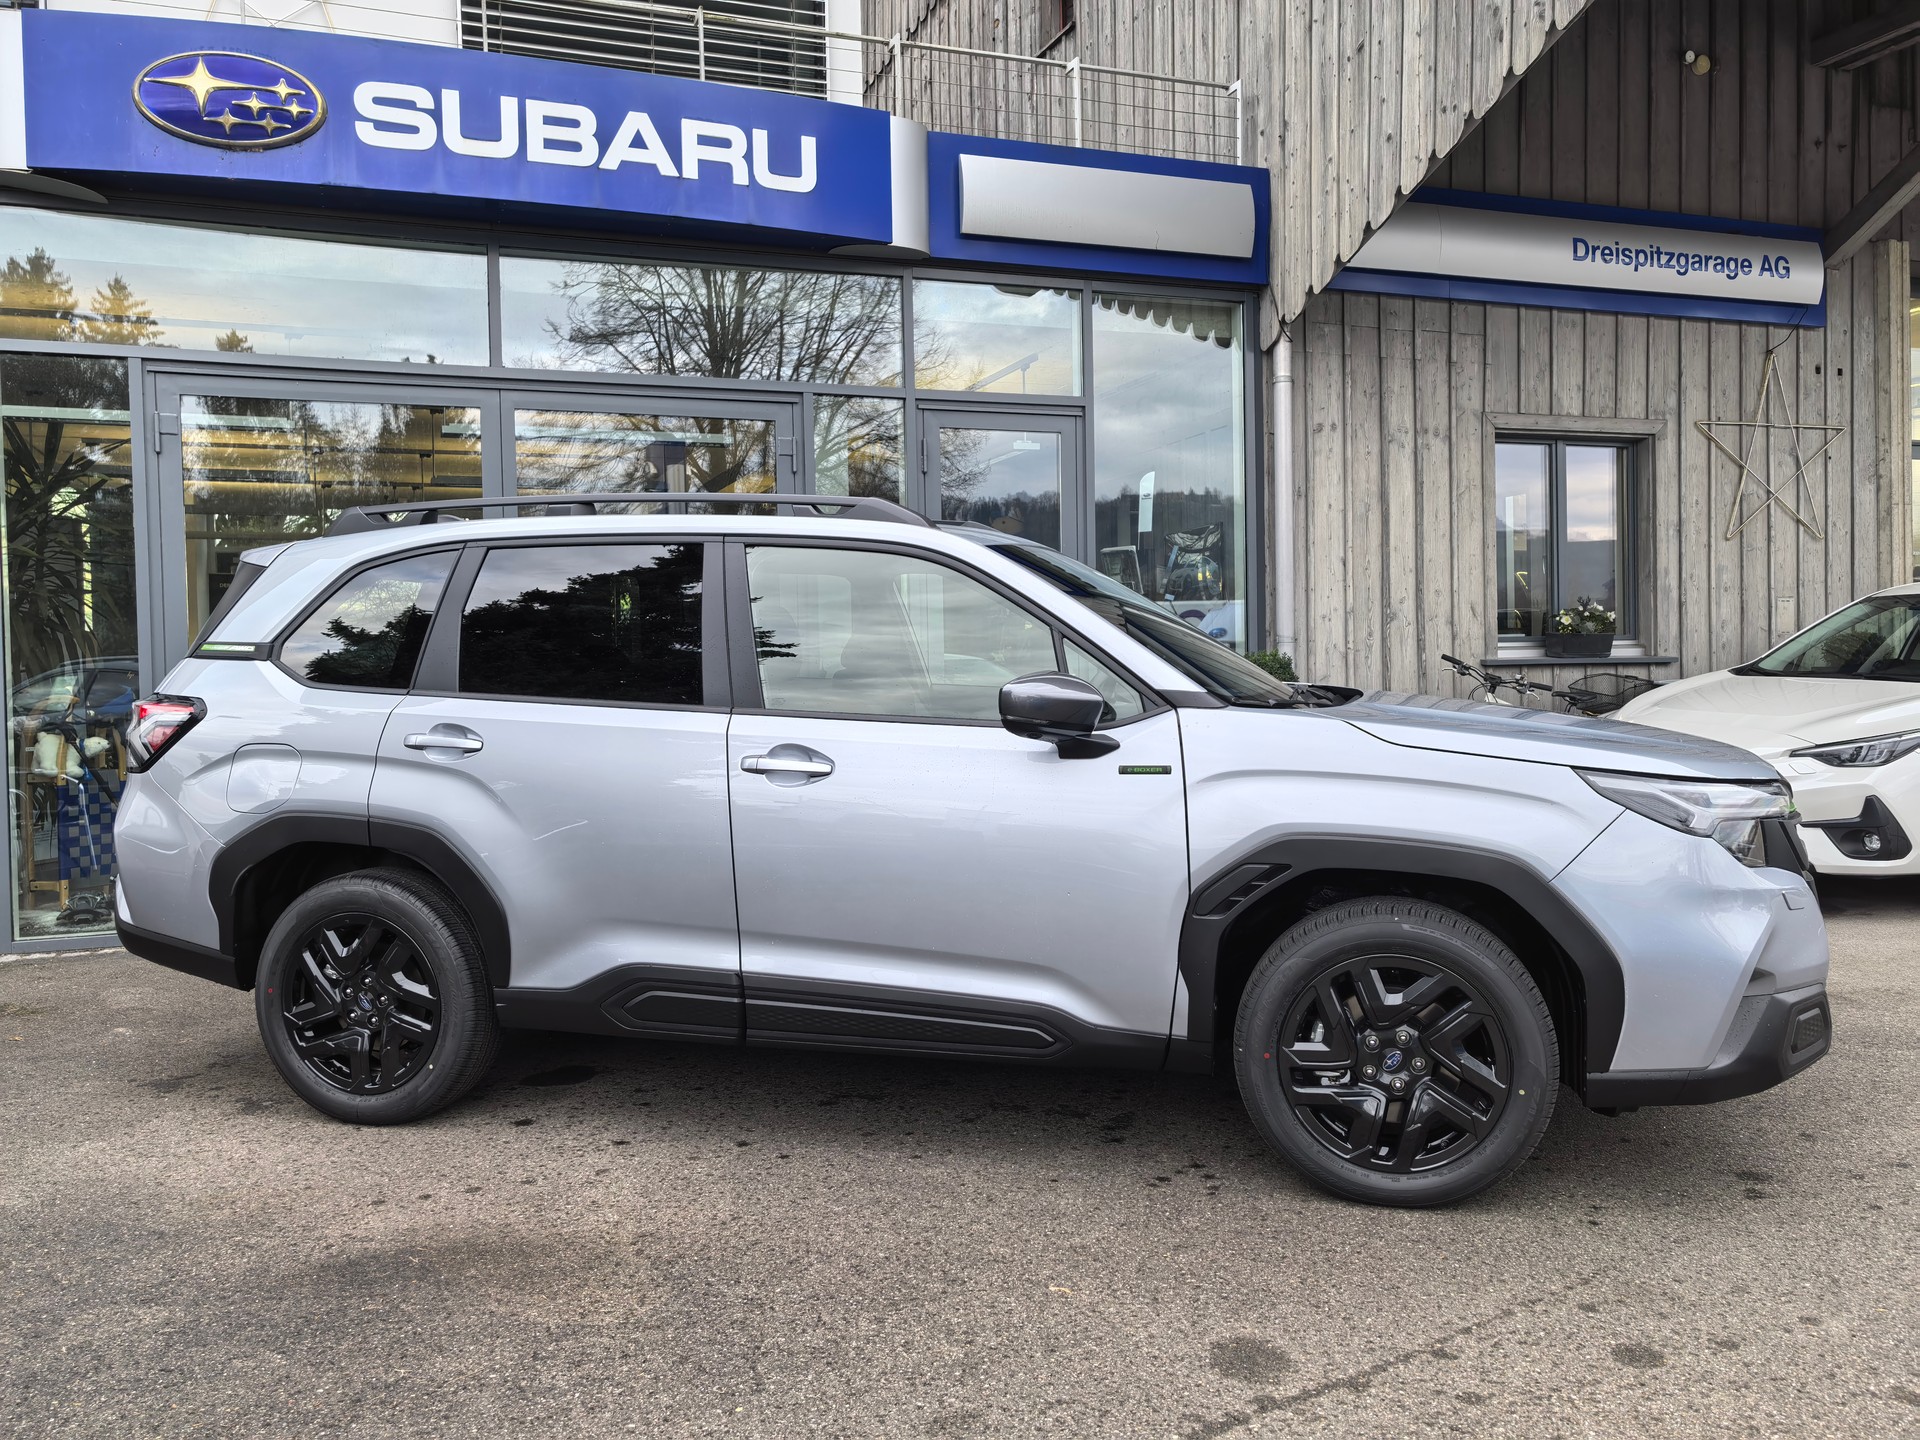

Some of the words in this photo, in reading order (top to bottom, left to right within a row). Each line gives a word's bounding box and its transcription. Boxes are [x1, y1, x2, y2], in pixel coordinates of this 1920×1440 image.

[353, 81, 817, 193] SUBARU
[1572, 237, 1753, 280] Dreispitzgarage
[1758, 254, 1791, 280] AG
